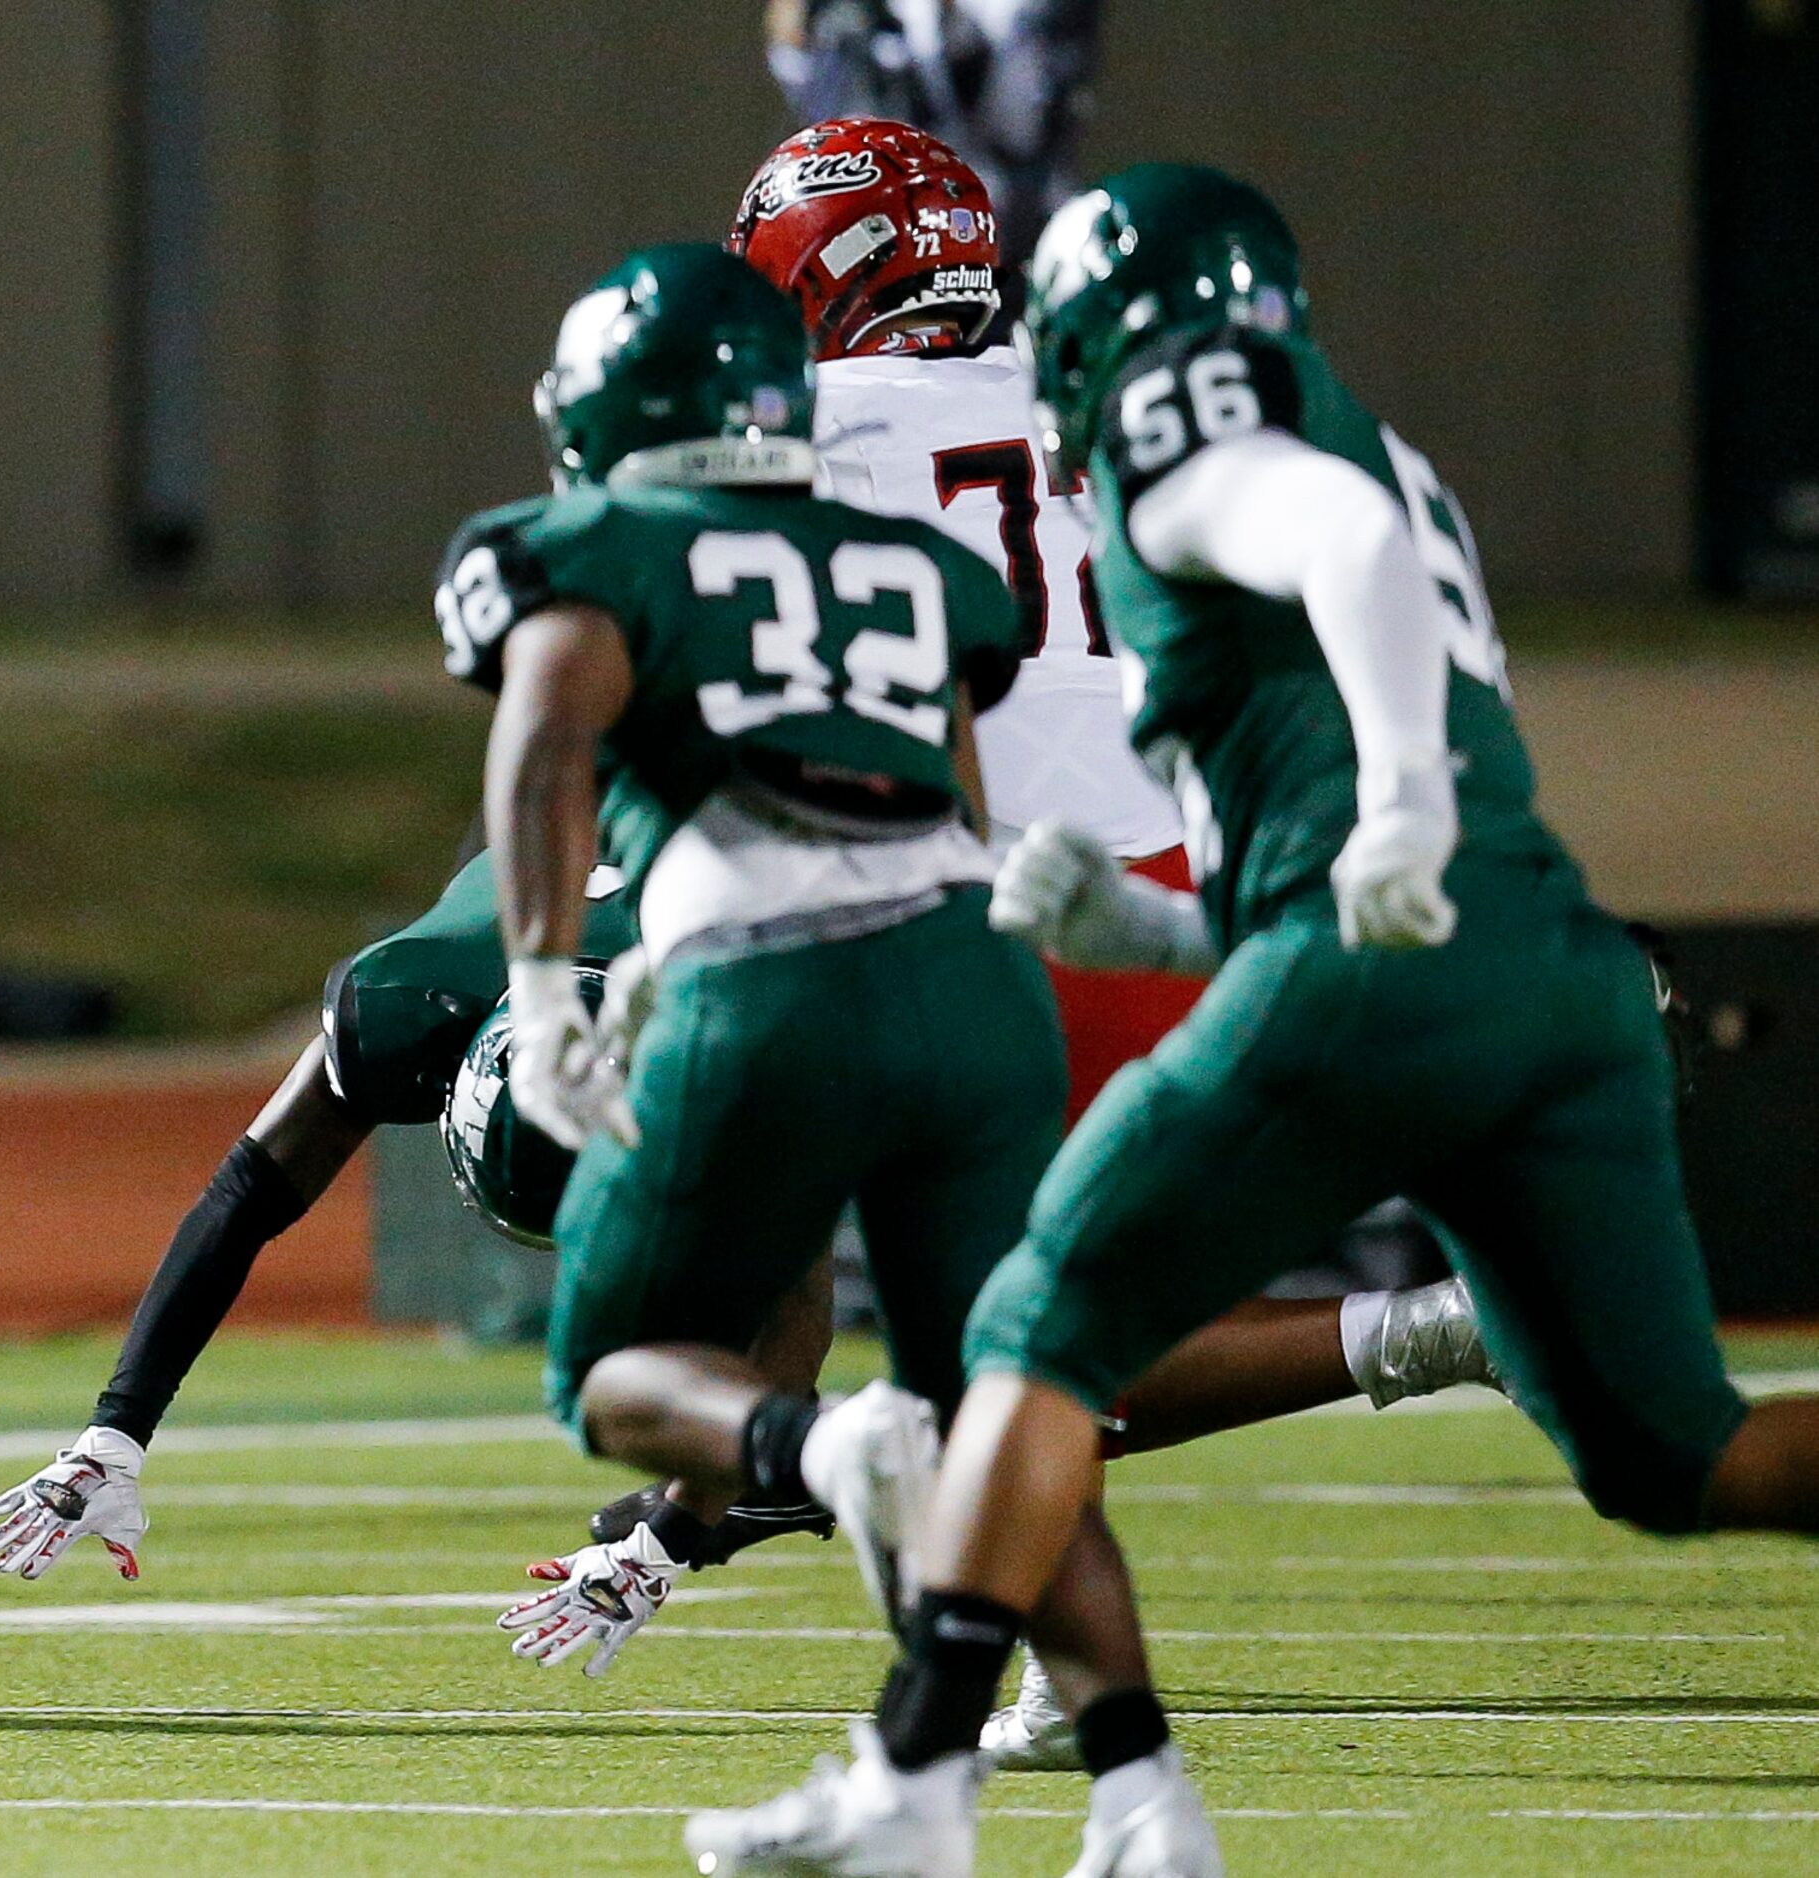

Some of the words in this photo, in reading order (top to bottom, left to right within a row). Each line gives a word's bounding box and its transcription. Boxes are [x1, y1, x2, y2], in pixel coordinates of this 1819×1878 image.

[913, 231, 942, 258] 72
[1120, 350, 1262, 472] 56
[931, 438, 1114, 659] 7
[689, 530, 948, 736] 32
